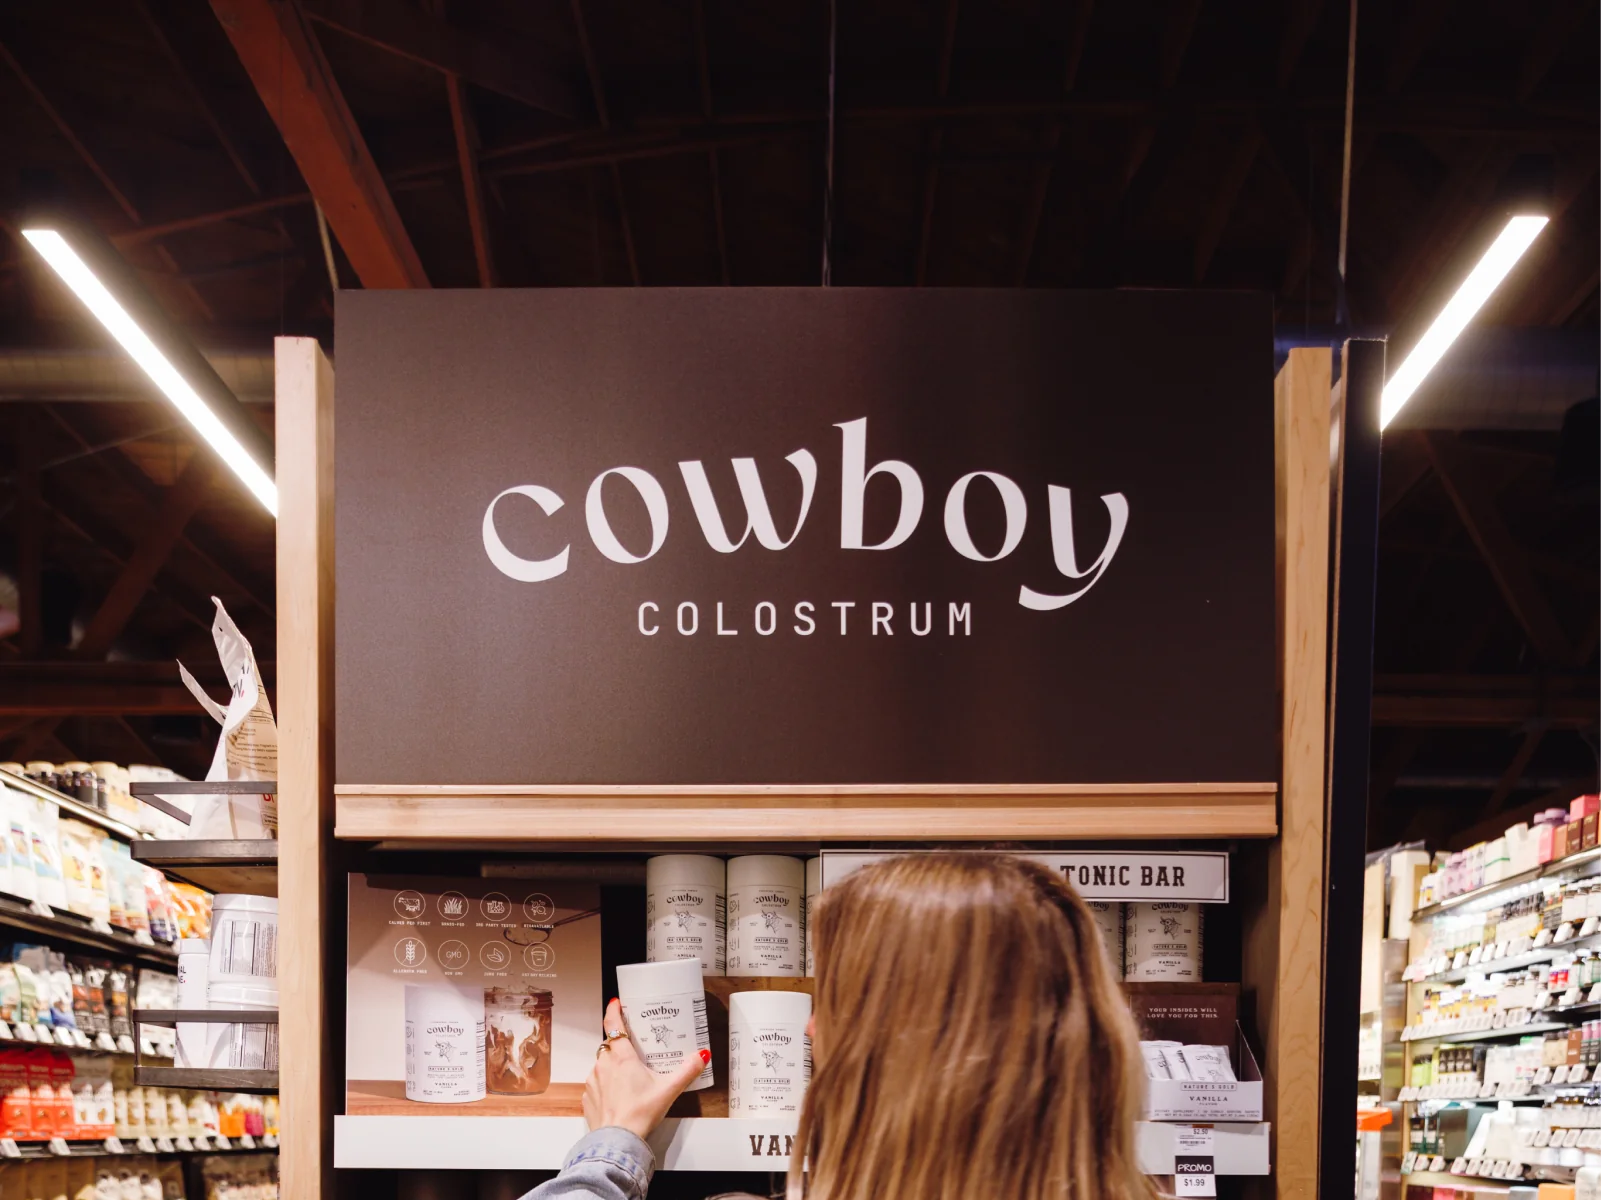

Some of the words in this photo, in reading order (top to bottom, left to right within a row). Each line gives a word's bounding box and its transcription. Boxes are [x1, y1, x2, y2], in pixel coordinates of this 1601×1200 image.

[481, 416, 1129, 611] cowboy
[637, 601, 972, 636] COLOSTRUM
[1060, 865, 1130, 886] TONIC
[1140, 866, 1185, 887] BAR
[666, 893, 703, 906] cowboy
[753, 893, 790, 906] cowboy
[445, 951, 462, 959] GMO
[640, 1006, 680, 1018] cowboy
[426, 1024, 464, 1036] cowboy
[753, 1032, 792, 1045] cowboy
[1177, 1163, 1212, 1173] PROMO
[1184, 1178, 1205, 1187] $1.99
